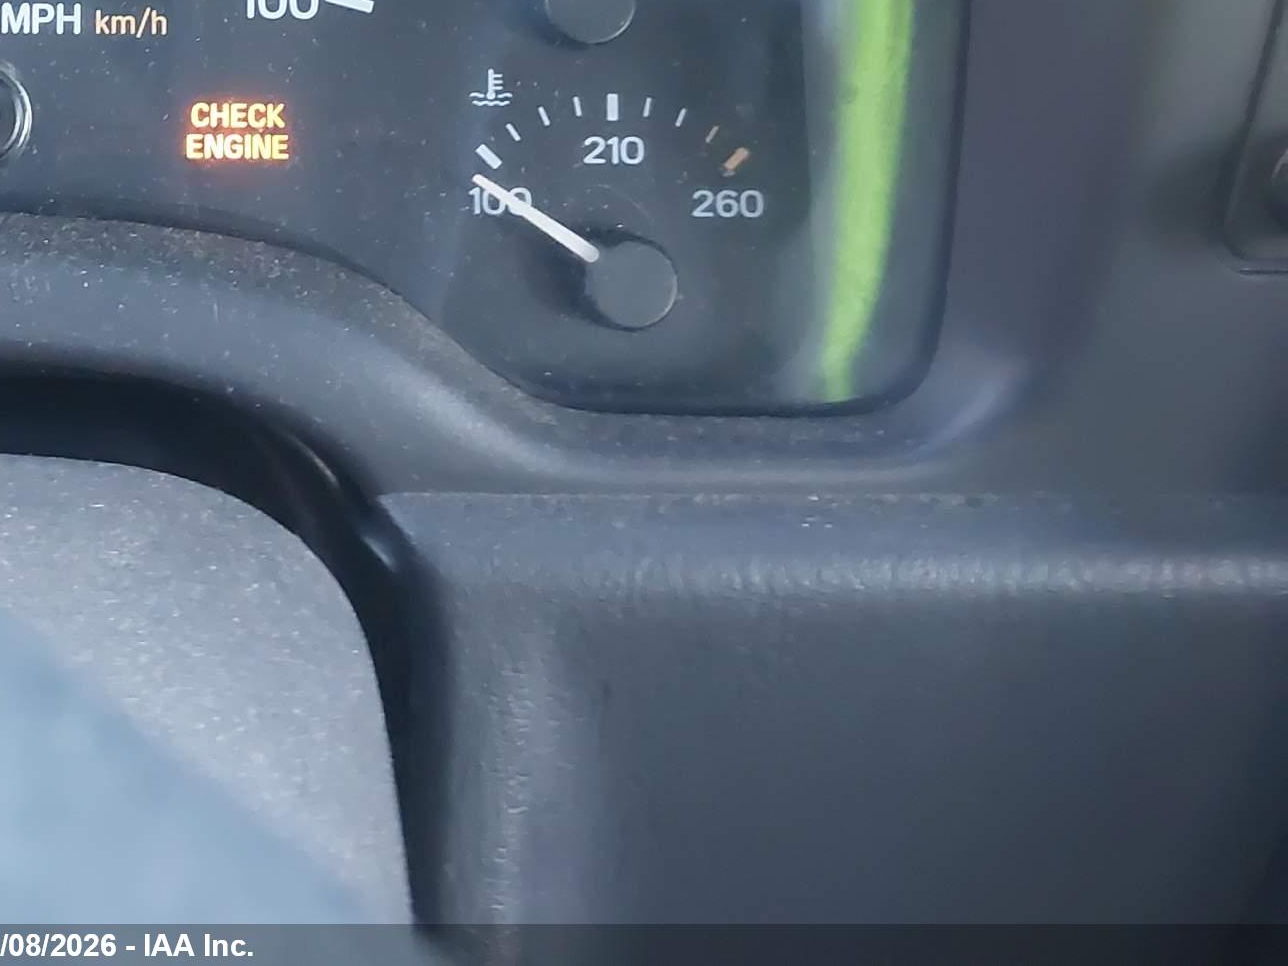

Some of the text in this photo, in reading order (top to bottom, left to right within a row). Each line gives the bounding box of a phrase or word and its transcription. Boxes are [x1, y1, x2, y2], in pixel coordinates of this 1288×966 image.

[1, 2, 168, 37] MPH km/h
[190, 101, 286, 130] CHECK
[186, 133, 289, 161] ENGINE
[583, 137, 645, 165] 210
[468, 187, 532, 215] 100
[692, 190, 764, 218] 260
